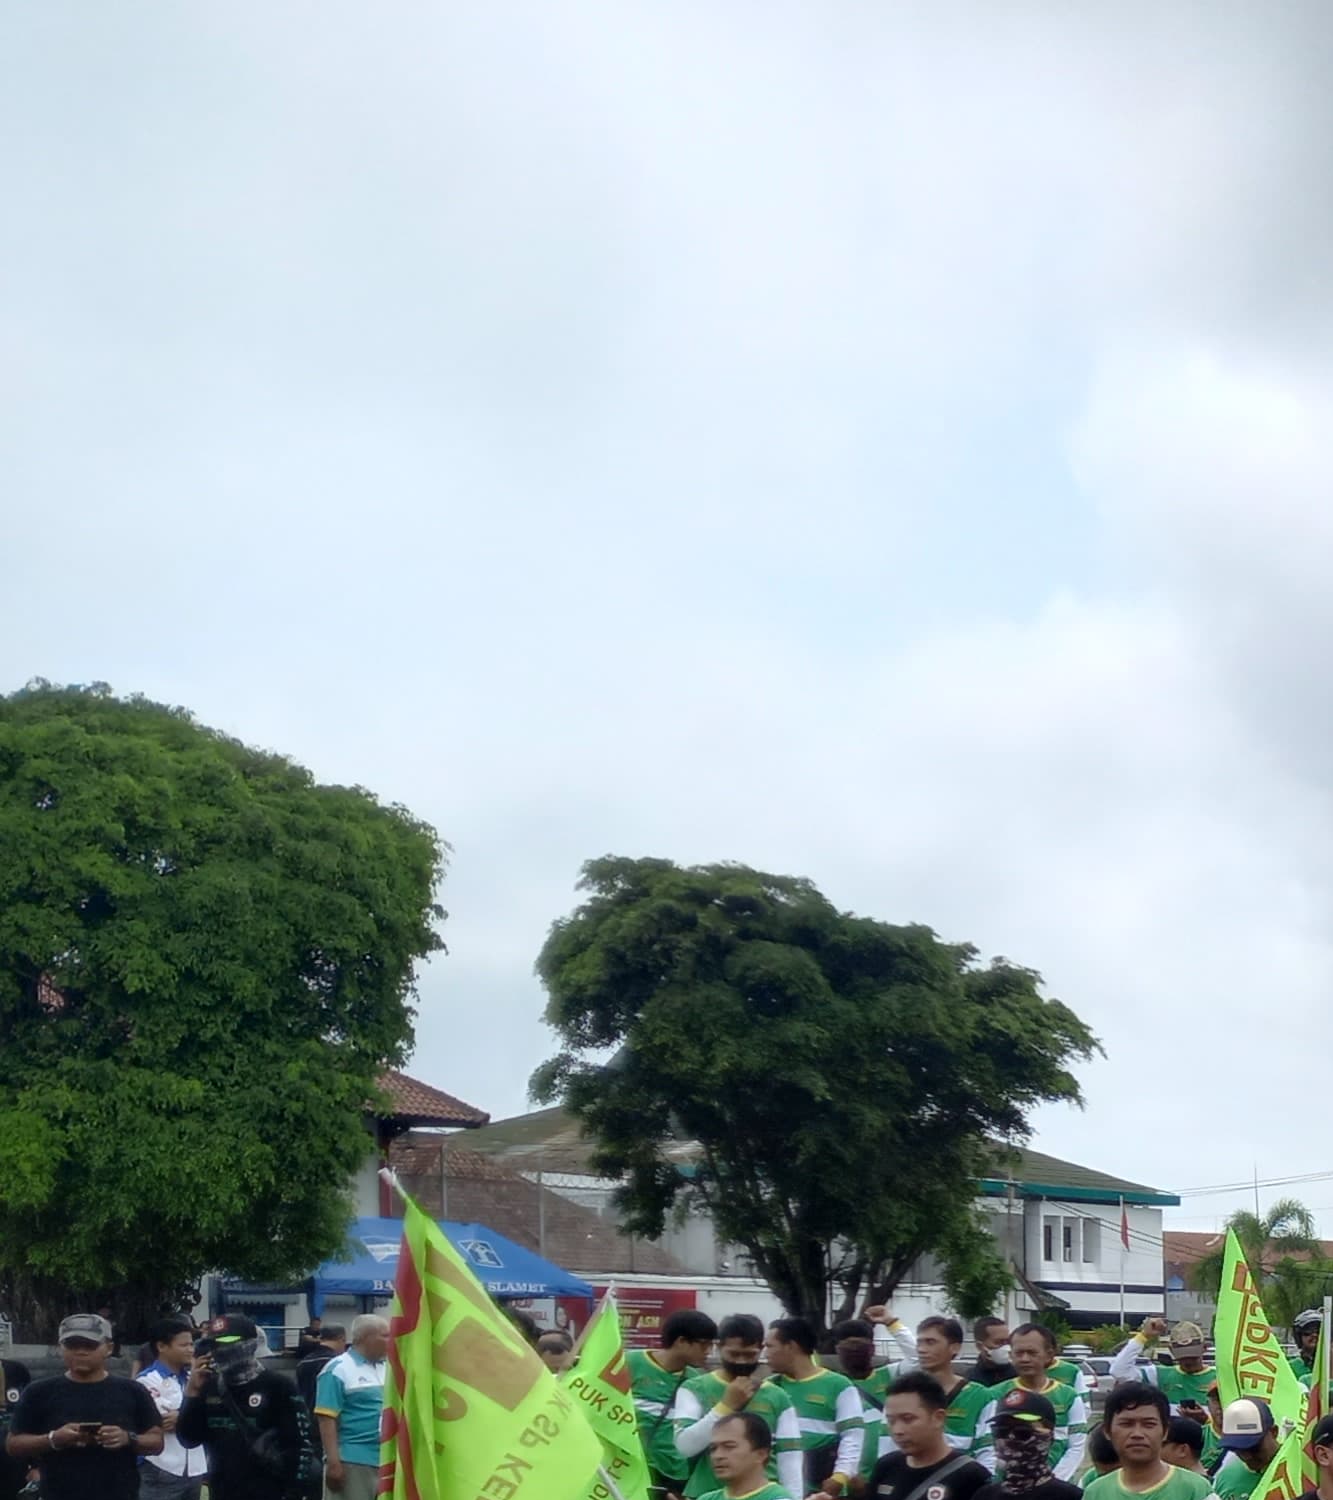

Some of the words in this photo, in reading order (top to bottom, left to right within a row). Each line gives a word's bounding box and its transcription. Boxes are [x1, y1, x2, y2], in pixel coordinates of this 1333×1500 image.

[488, 1281, 548, 1293] SLAMET
[569, 1377, 608, 1412] PUK
[607, 1405, 634, 1425] SP
